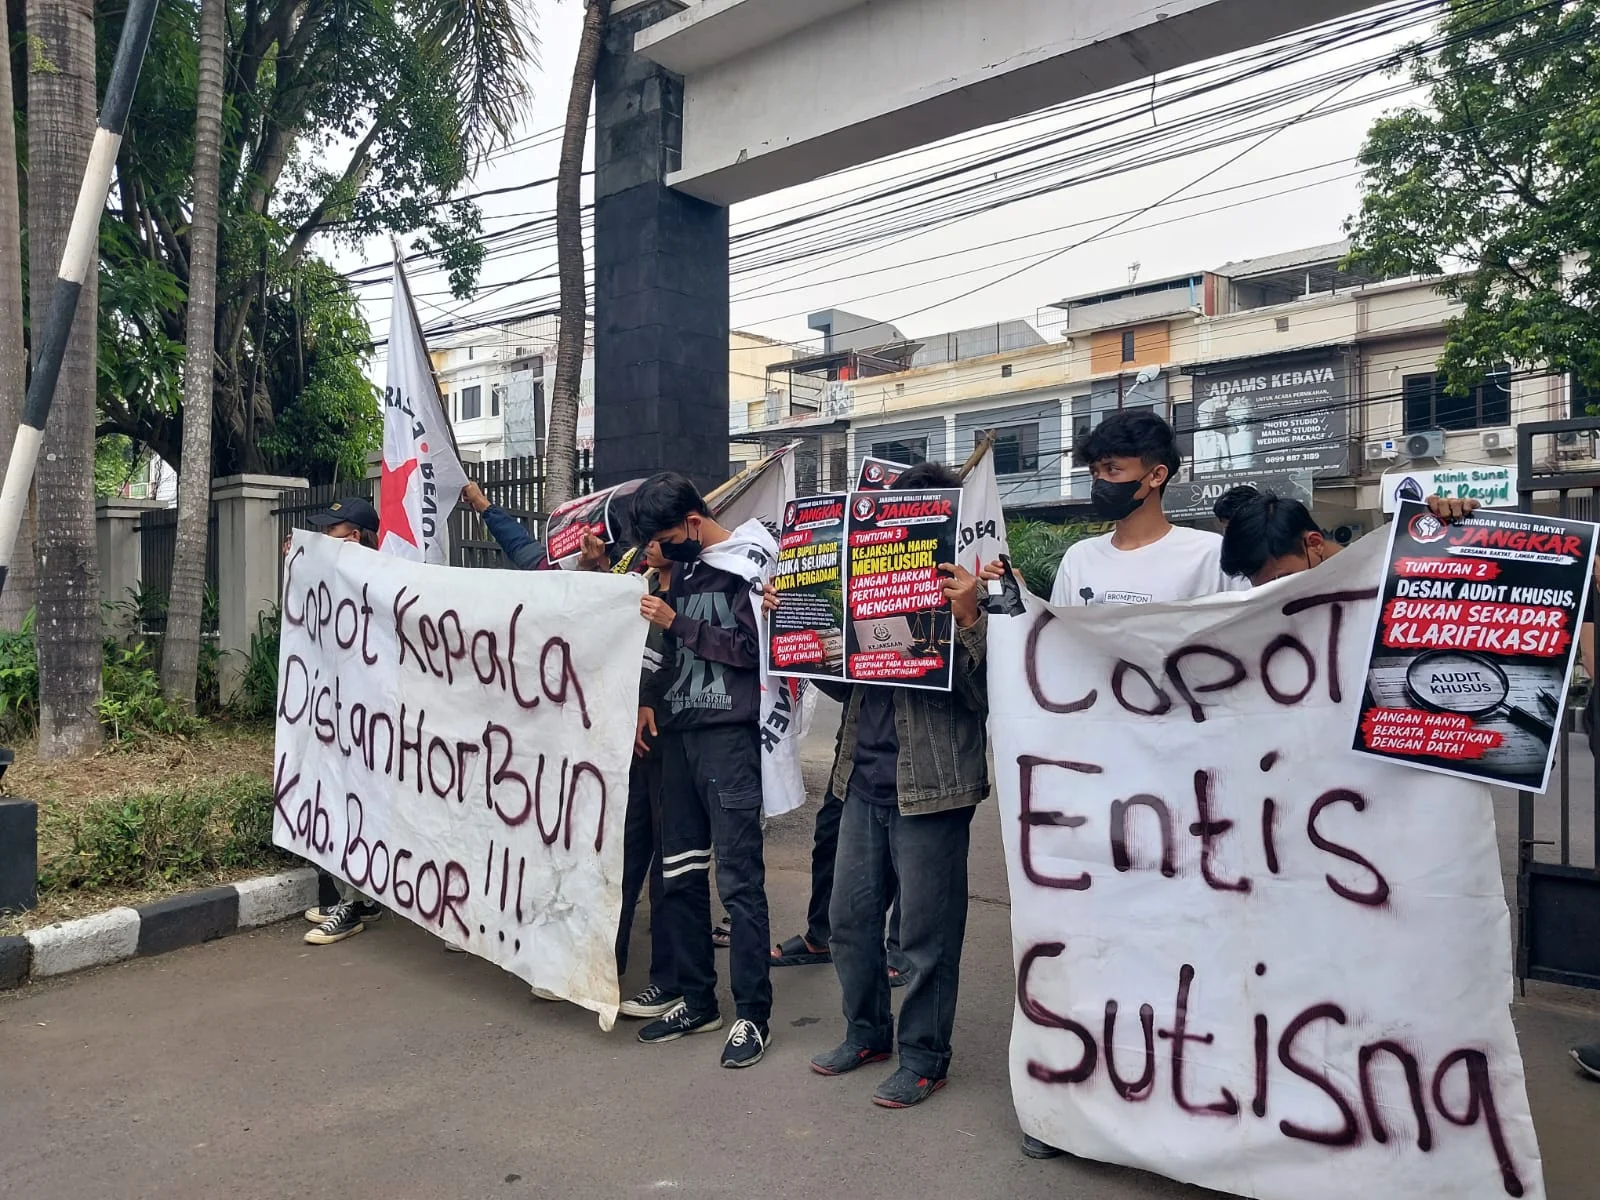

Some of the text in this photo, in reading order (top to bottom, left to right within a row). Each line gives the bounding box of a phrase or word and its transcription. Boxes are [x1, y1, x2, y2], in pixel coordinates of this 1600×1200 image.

[1210, 367, 1335, 397] ADAMS KEBAYA
[1290, 417, 1318, 427] STUDIO
[1292, 425, 1321, 434] STUDIO
[1256, 436, 1290, 445] WEDDING
[1433, 469, 1509, 483] Klinik Sunat
[795, 503, 843, 525] JANGKAR
[876, 498, 952, 521] JANGKAR
[855, 530, 902, 544] TUNTUTAN 3
[1499, 521, 1531, 530] KOALISI
[1533, 525, 1566, 535] RAKYAT
[852, 538, 939, 561] KEJAKSAAN HARUS
[1449, 527, 1583, 557] JANGKAR
[776, 551, 838, 577] BUKA SELURUH
[852, 551, 937, 577] MENELUSURI,
[1405, 561, 1488, 576] TUNTUTAN 2
[797, 566, 840, 587] PENGADAAN!
[852, 569, 931, 590] JANGAN BIARKAN
[852, 579, 942, 602] PERTANYAAN PUBLI
[1107, 593, 1148, 603] BROMPTON
[1396, 579, 1459, 599] DESAK
[1510, 586, 1576, 610] KHUSUS,
[856, 591, 943, 617] MENGGANTUNG!
[1391, 601, 1564, 629] BUKAN SEKADAR
[284, 544, 379, 666] Copot
[394, 585, 592, 730] Kepala
[868, 641, 903, 651] KEJAKSAAN
[1388, 622, 1560, 654] KLARIFIKASI!
[777, 644, 797, 654] BUKAN
[853, 652, 895, 662] HUKUM HARUS
[856, 669, 875, 677] BUKAN
[1431, 672, 1482, 683] AUDIT
[1430, 683, 1492, 694] KHUSUS
[1372, 711, 1467, 729] JANGAN HANYA
[1373, 725, 1494, 744] BERKATA, BUKTIKAN
[1371, 737, 1465, 755] DENGAN DATA!
[272, 752, 336, 856] Kab.
